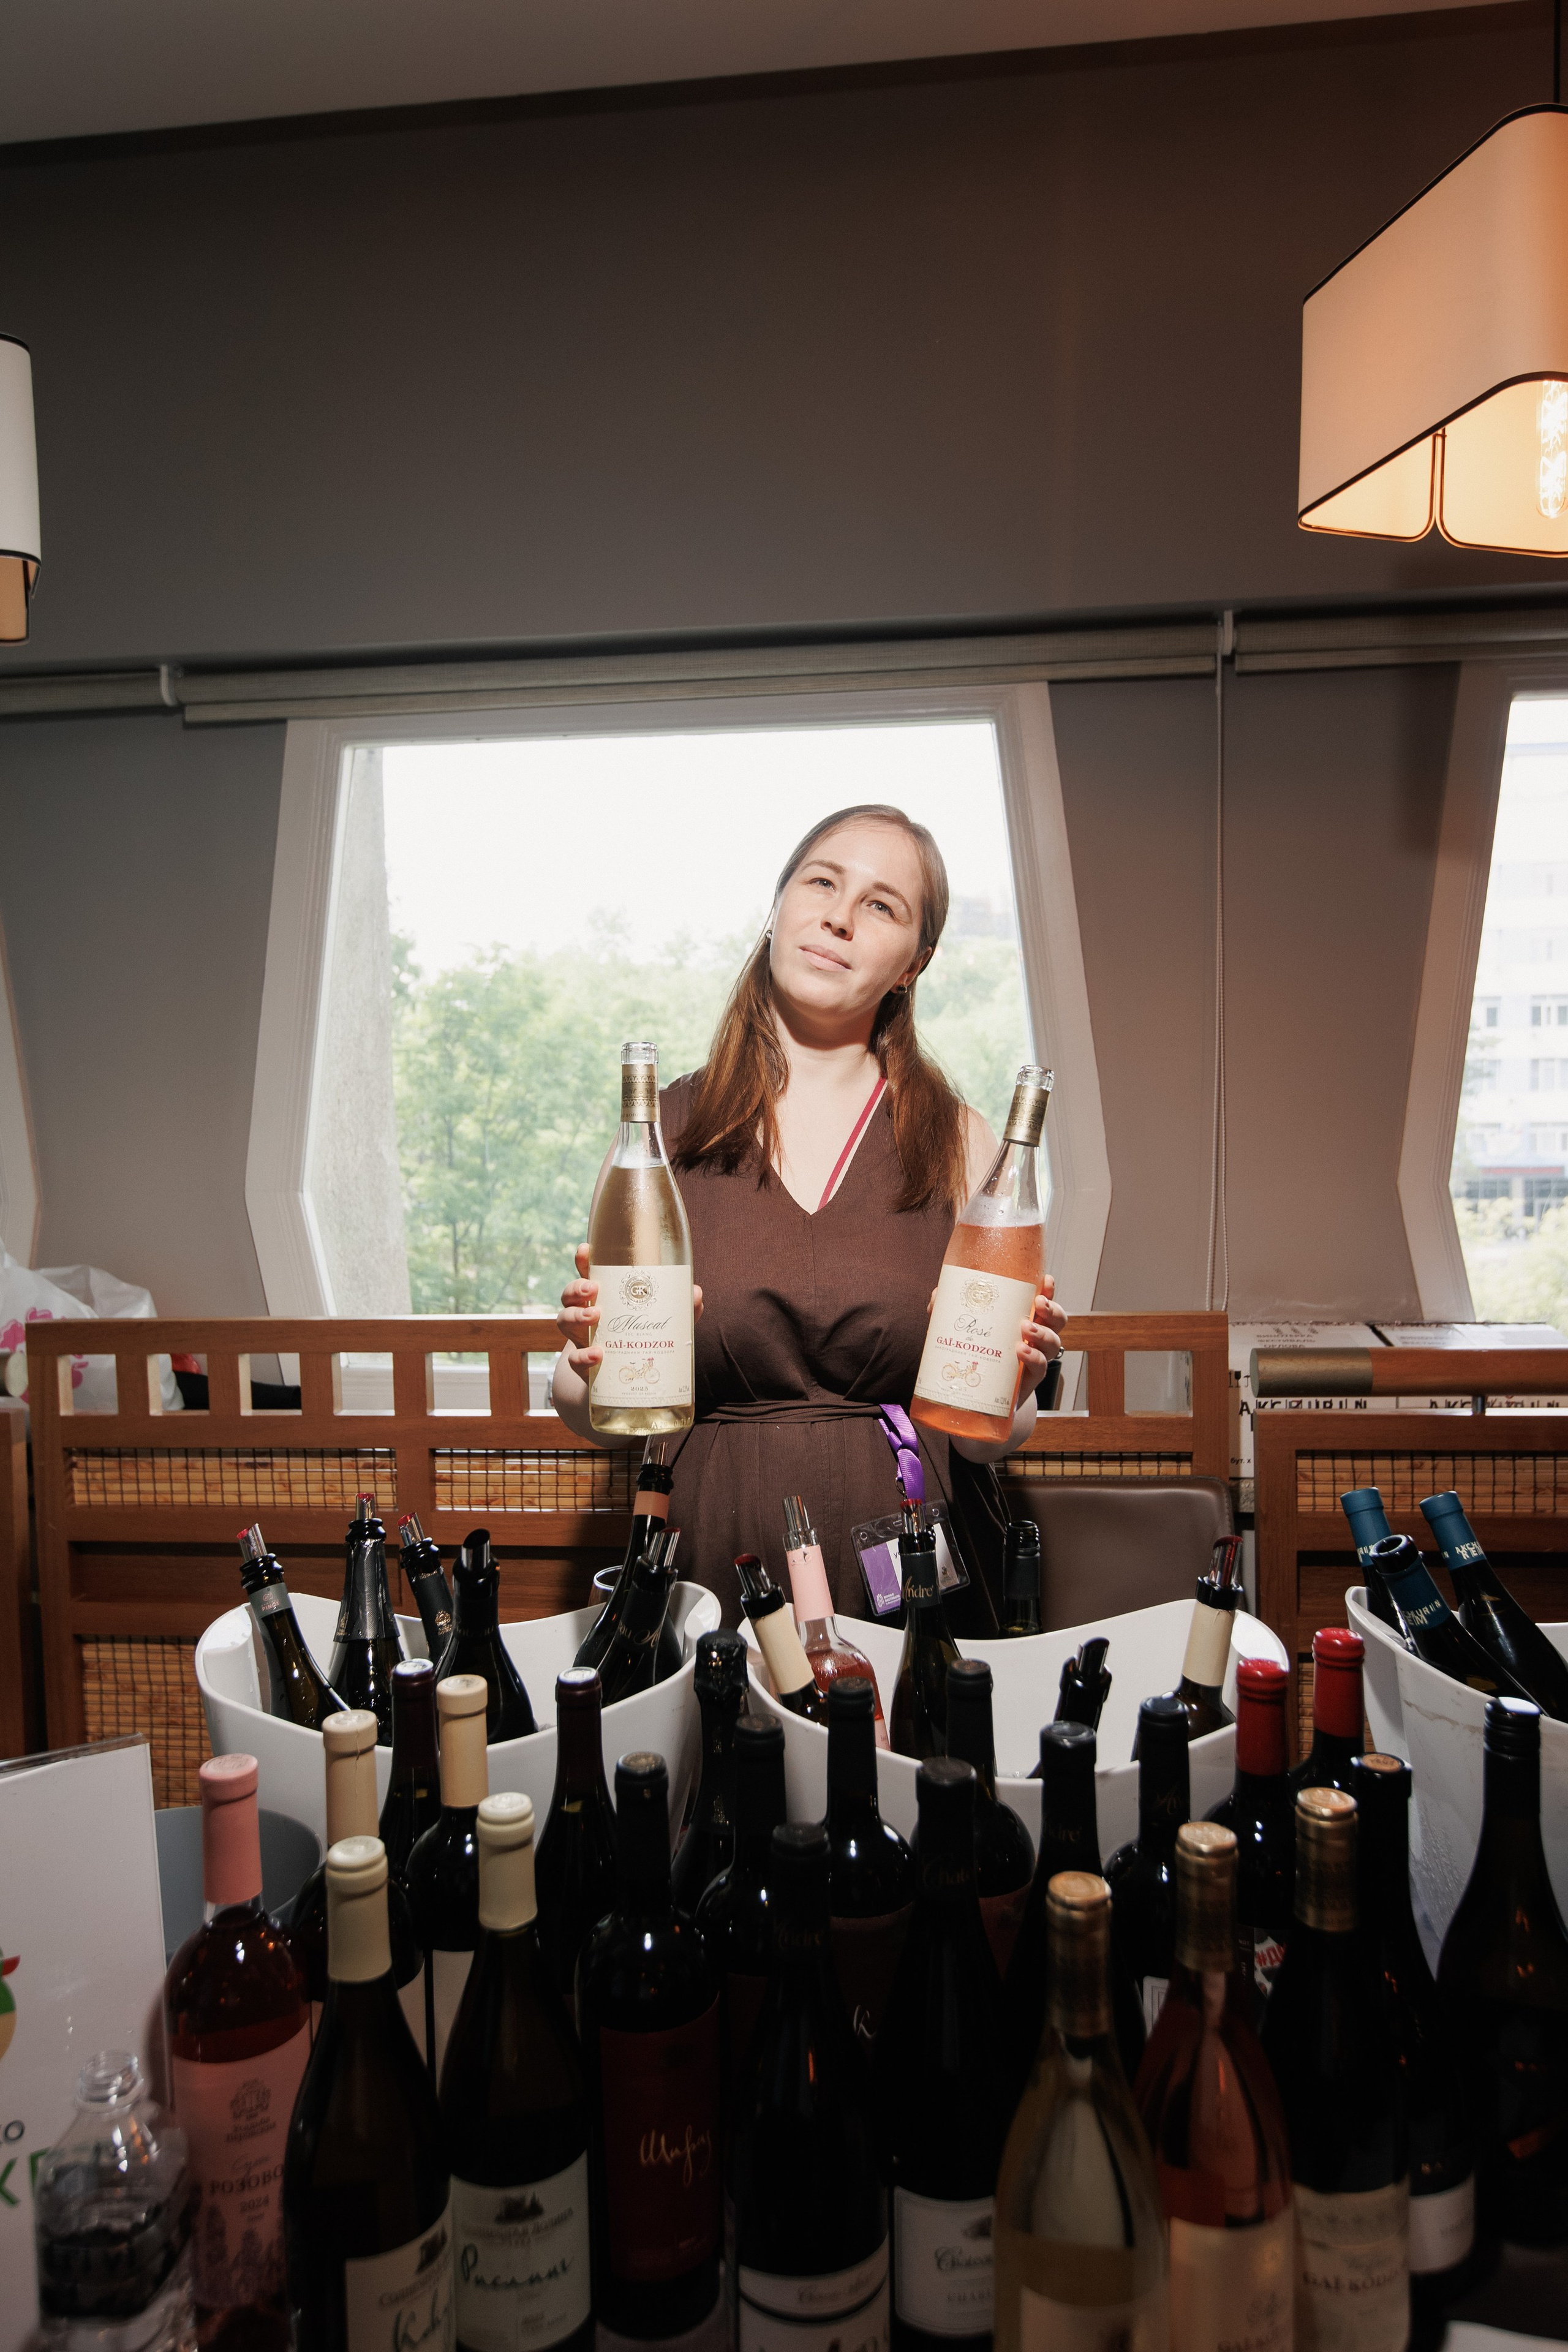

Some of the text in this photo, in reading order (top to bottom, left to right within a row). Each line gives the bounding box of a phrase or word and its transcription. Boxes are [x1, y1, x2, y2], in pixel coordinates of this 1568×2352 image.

[607, 1314, 673, 1333] Muscat
[954, 1314, 993, 1338] Rosé
[605, 1340, 674, 1349] GAÏ-KODZOR
[937, 1336, 1003, 1358] GAÏ-KODZOR
[209, 2163, 284, 2196] РОЗОВО
